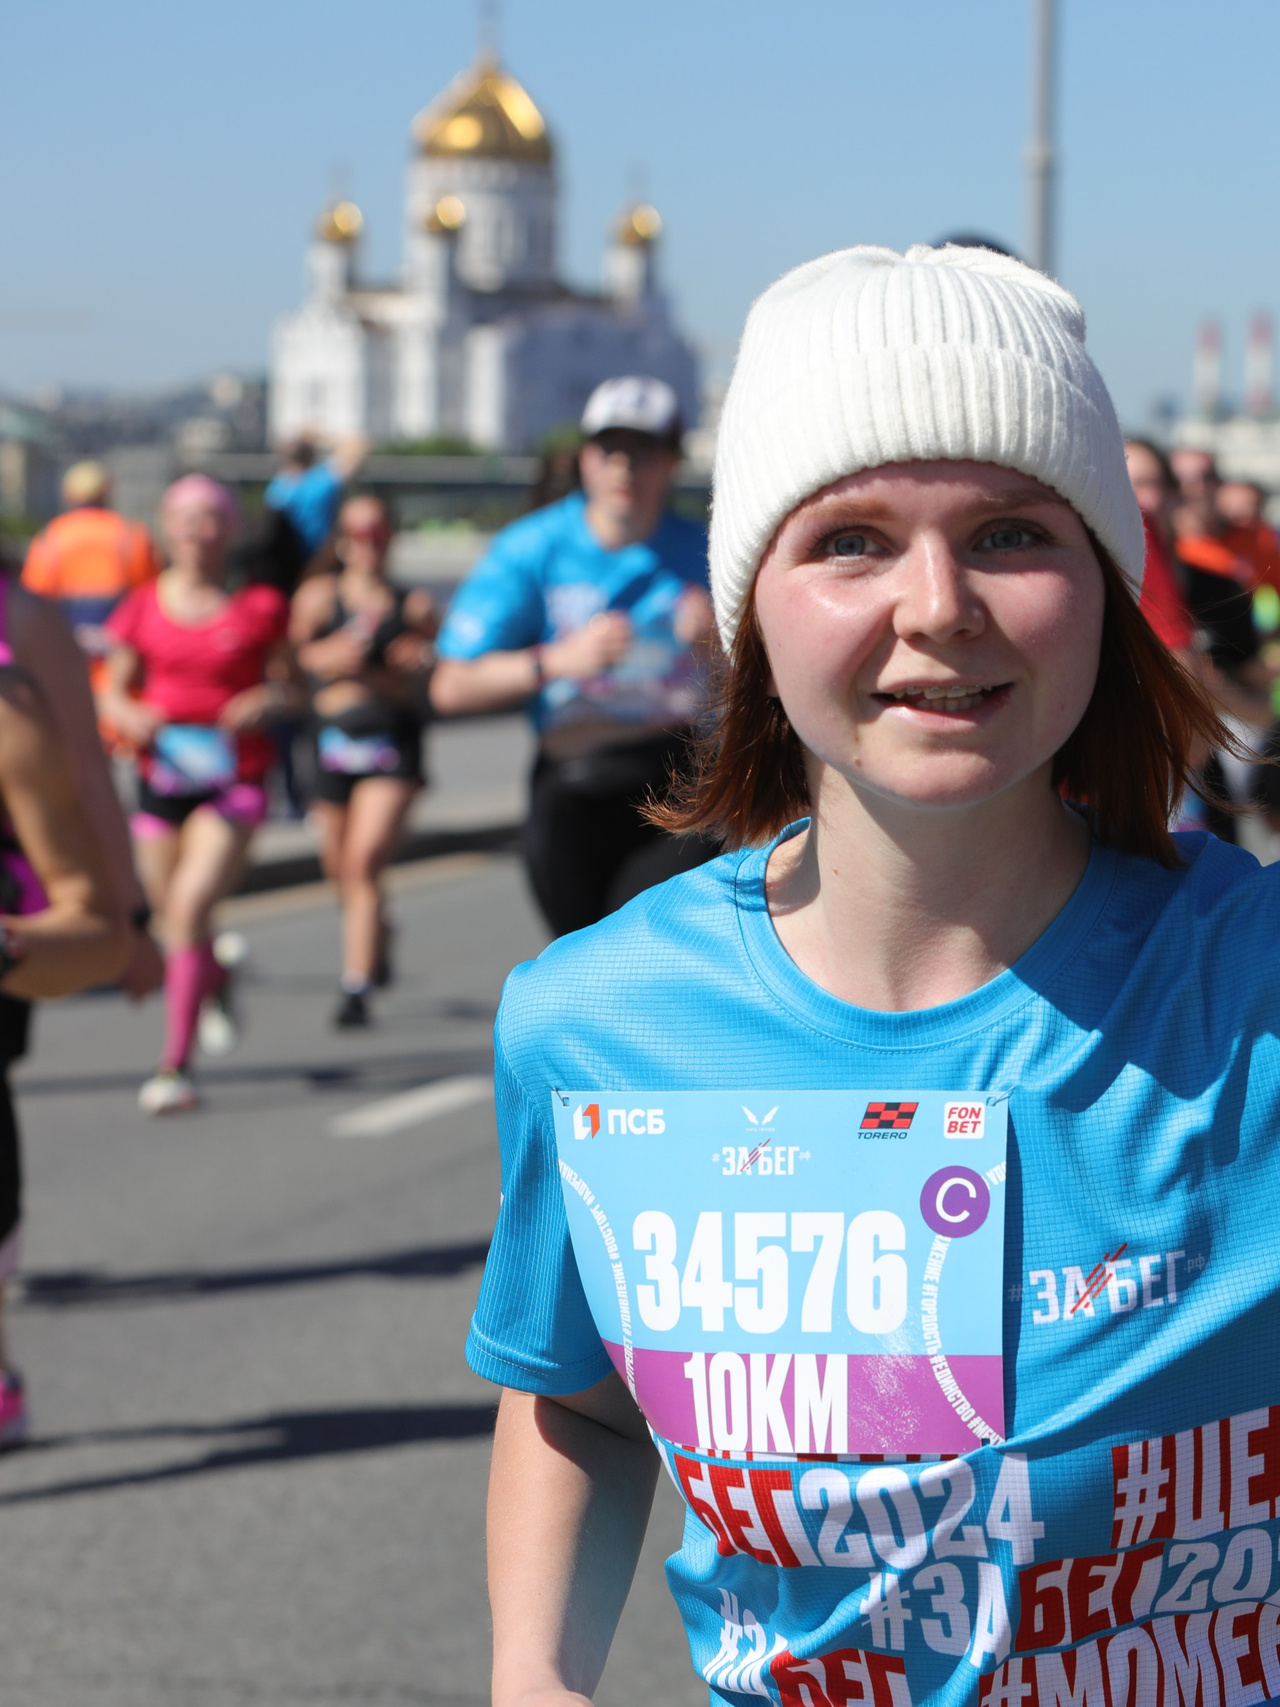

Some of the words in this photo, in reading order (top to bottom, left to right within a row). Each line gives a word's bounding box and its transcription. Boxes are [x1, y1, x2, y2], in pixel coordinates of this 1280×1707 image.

[607, 1108, 666, 1135] ПСБ
[947, 1107, 982, 1119] FON
[858, 1132, 908, 1140] TORERO
[947, 1121, 981, 1133] BET
[632, 1210, 908, 1334] 34576
[929, 1354, 976, 1422] #ЕДИНСТВО
[670, 1451, 1045, 1568] БЕГ2024
